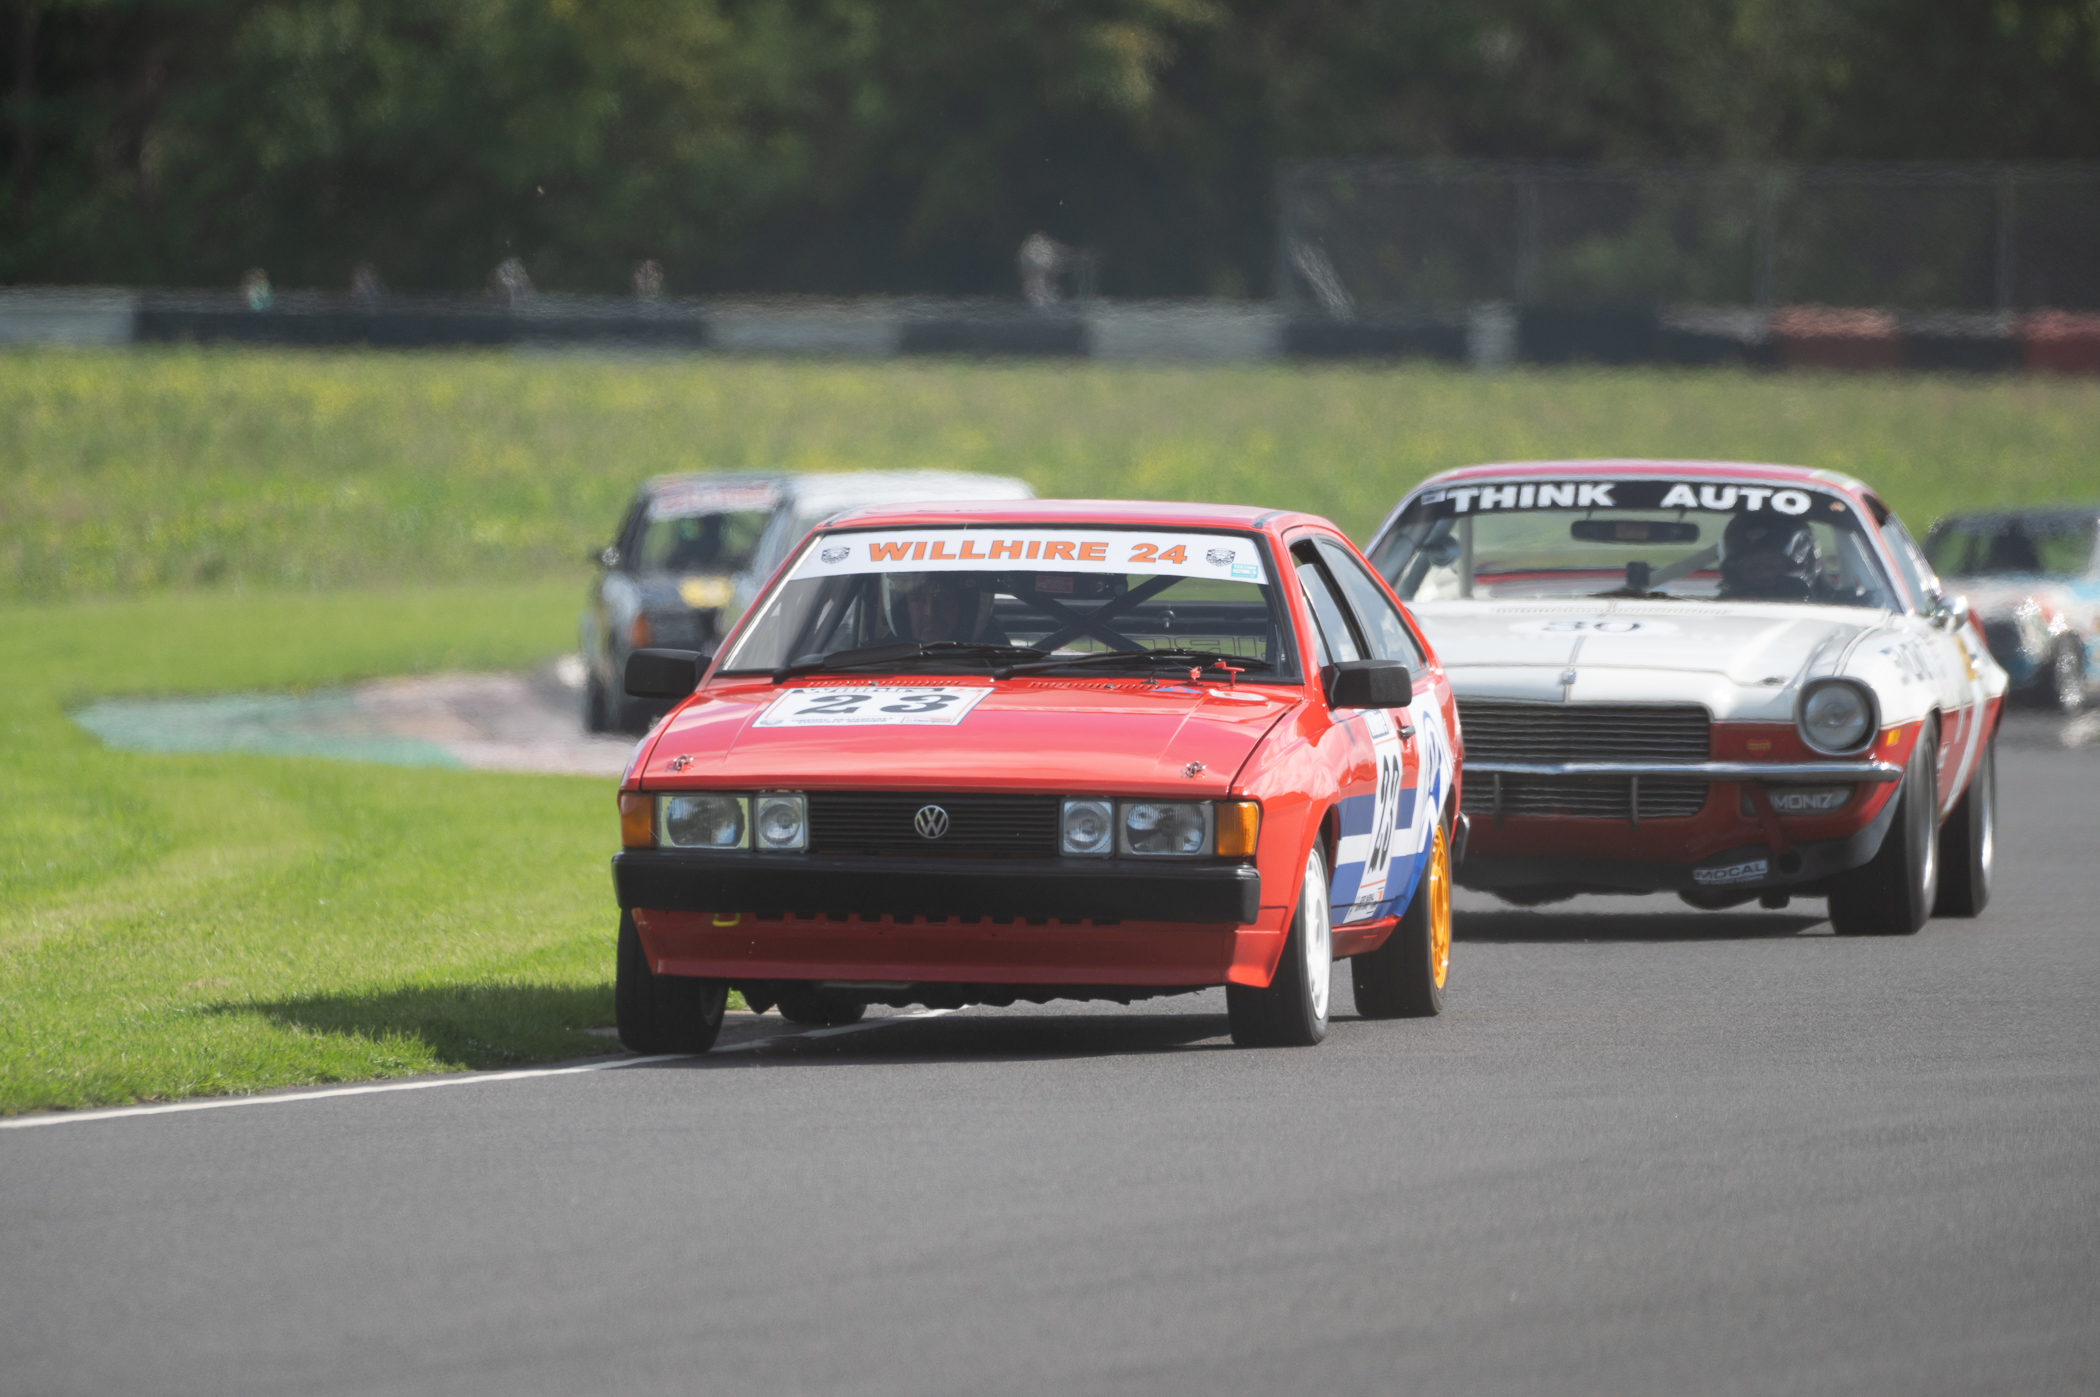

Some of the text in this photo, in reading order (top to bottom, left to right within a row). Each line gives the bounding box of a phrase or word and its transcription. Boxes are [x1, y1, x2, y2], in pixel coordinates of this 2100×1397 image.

[1446, 482, 1813, 516] THINK AUTO
[869, 539, 1110, 563] WILLHIRE
[1128, 542, 1188, 564] 24
[794, 694, 960, 715] 23
[1367, 755, 1399, 874] 23
[1696, 862, 1766, 879] MOCAL
